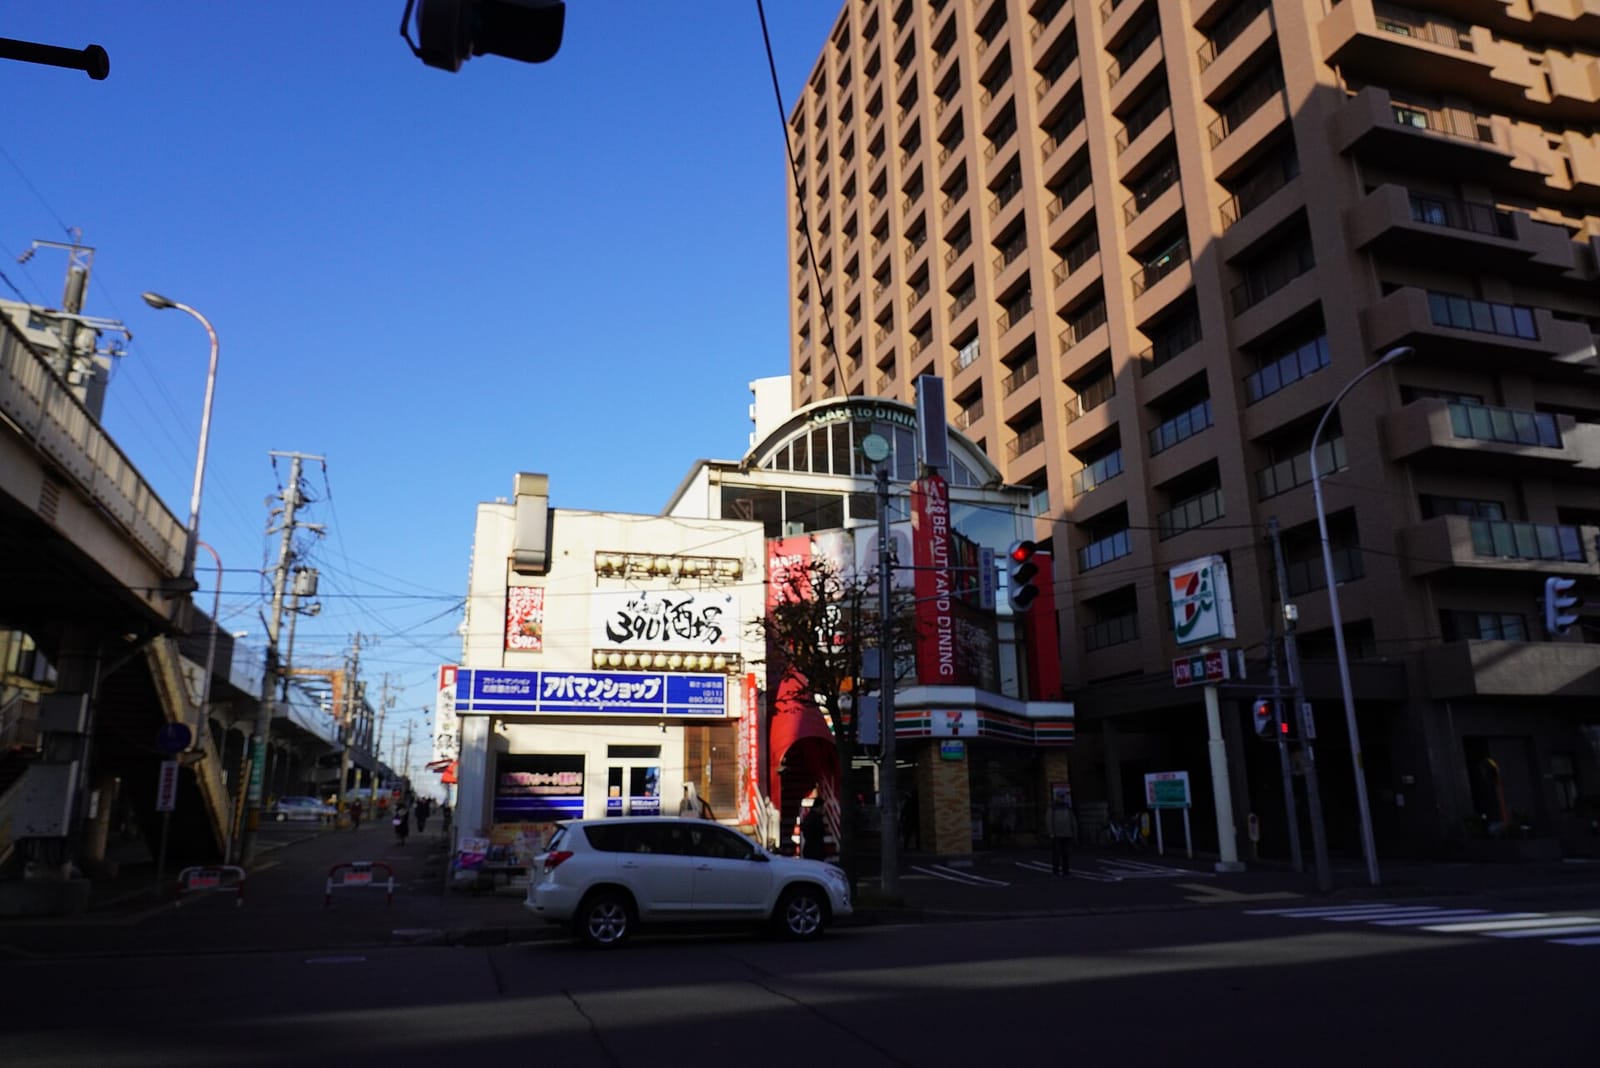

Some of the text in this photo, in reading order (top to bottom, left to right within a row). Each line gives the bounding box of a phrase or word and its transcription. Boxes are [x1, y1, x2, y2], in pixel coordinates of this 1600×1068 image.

[859, 407, 873, 418] to
[876, 408, 918, 428] DININ
[933, 516, 954, 676] BEAUTY AND DINING
[543, 675, 662, 700] アパマンショップ
